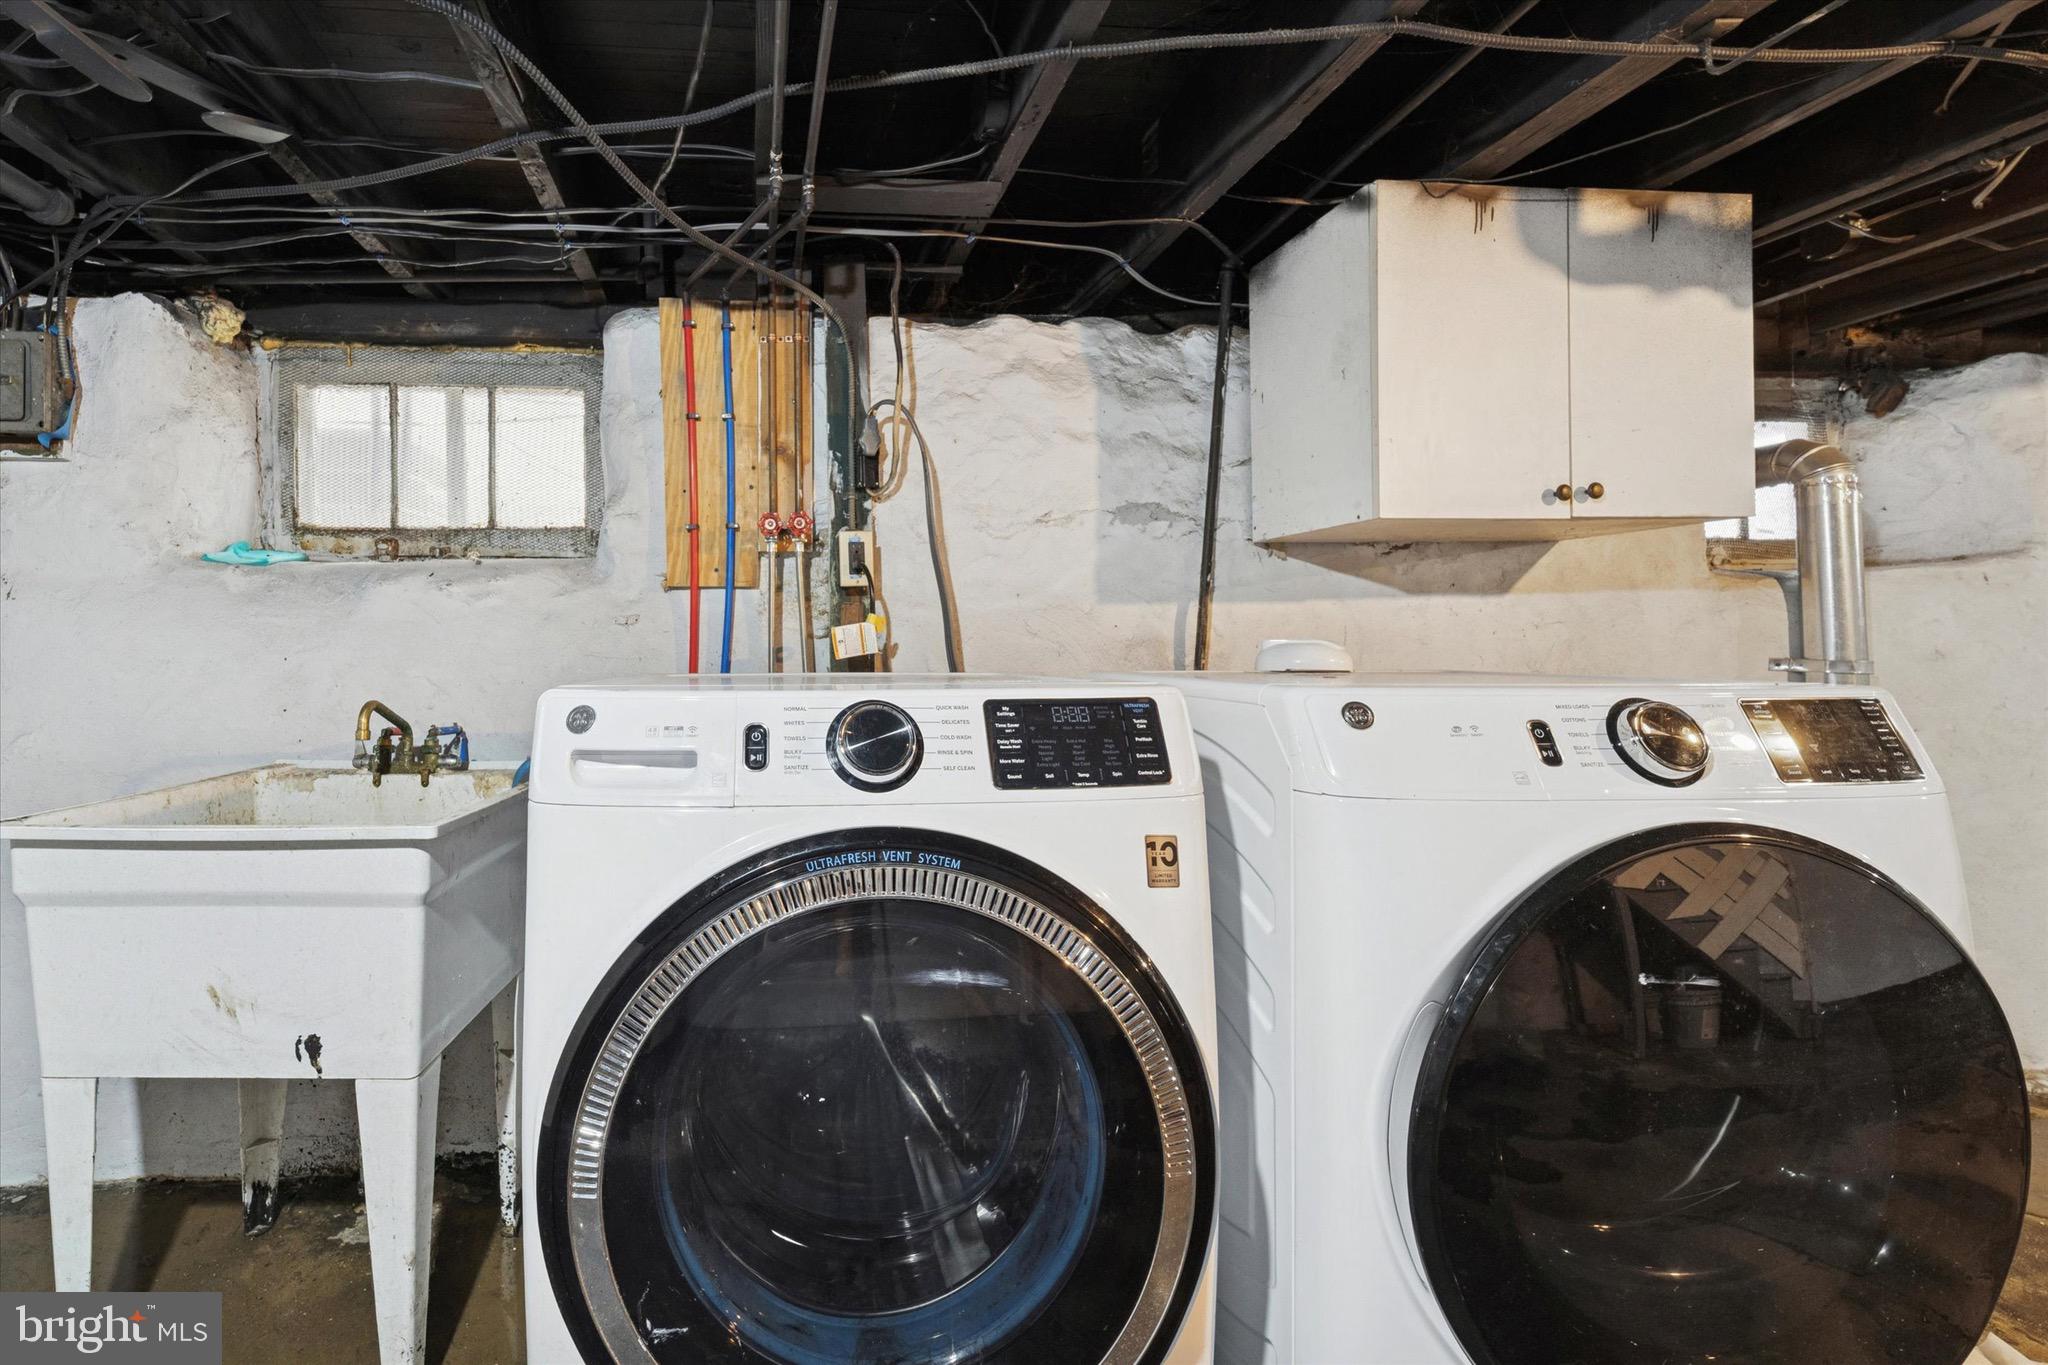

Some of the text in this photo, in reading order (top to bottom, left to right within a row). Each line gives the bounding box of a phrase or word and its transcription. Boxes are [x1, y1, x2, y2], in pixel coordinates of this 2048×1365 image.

[805, 850, 961, 872] ULTRAFRESH VENT SYSTEM
[1146, 841, 1178, 867] 10
